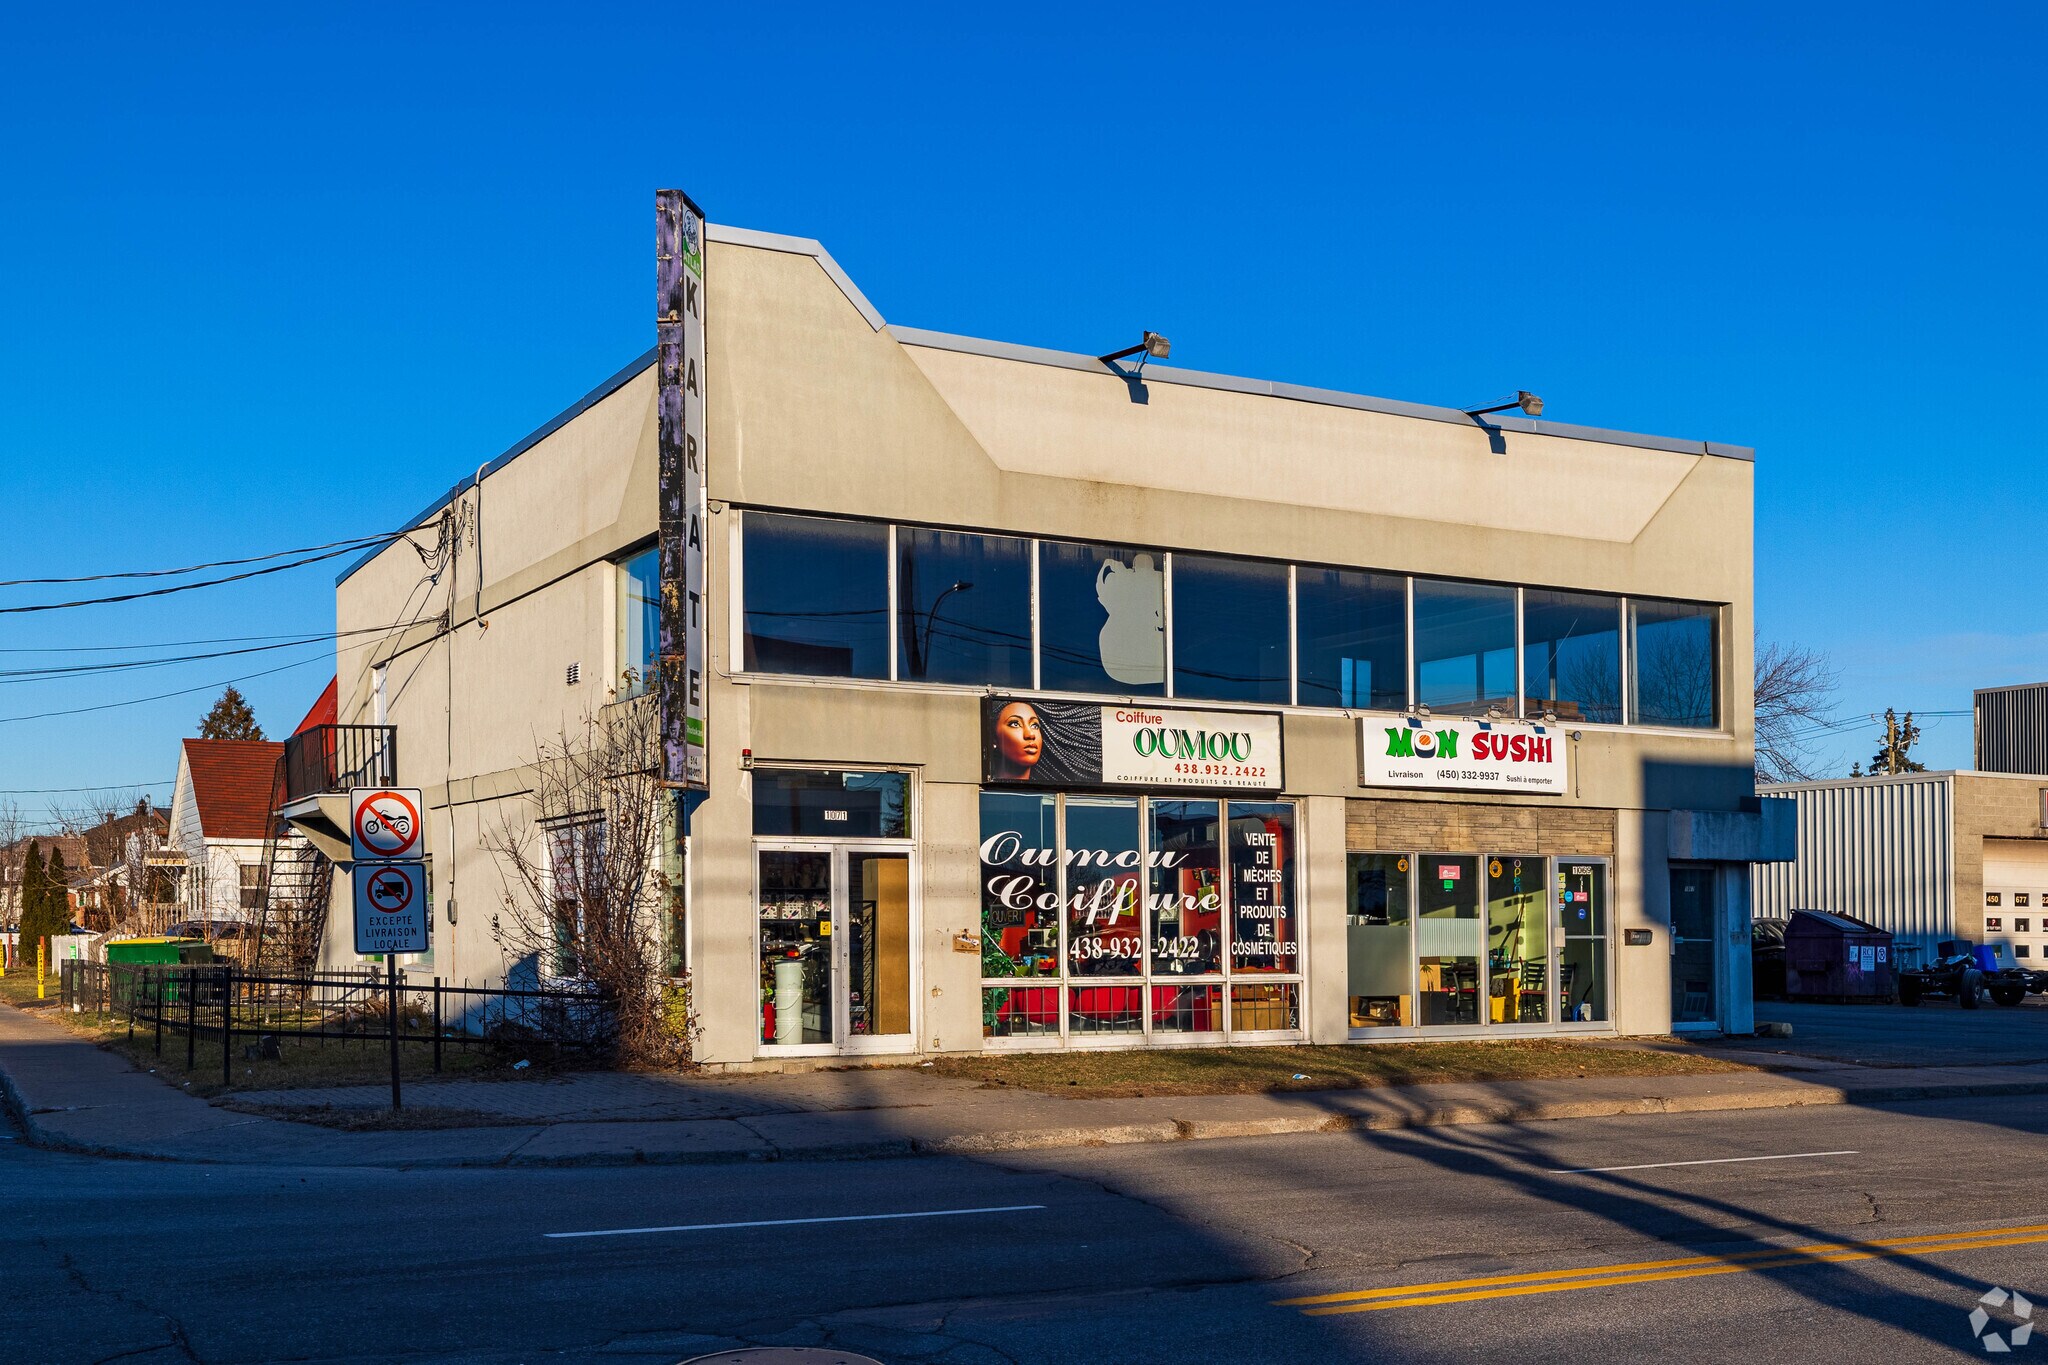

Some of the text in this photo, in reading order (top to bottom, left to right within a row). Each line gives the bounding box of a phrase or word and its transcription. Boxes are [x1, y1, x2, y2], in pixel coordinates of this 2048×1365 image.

[686, 275, 701, 708] KARATE
[1115, 711, 1163, 725] Coiffure
[1133, 727, 1252, 762] OUMOU
[1384, 727, 1553, 763] MON SUSHI
[1174, 763, 1267, 778] 438.932.2422
[1388, 769, 1500, 781] Livraison (450) 332-9937
[1116, 774, 1159, 783] COIFFURE
[1177, 777, 1218, 785] PRODUITS
[1237, 779, 1267, 787] BEAUTÉ
[1506, 774, 1553, 786] Sushi à emporter
[1246, 833, 1276, 847] VENTE
[979, 830, 1189, 868] Oumou
[1256, 851, 1269, 864] DE
[1243, 866, 1282, 883] MÈCHES
[987, 875, 1222, 925] Coiffure
[1256, 887, 1268, 901] ET
[1986, 895, 1999, 903] 450
[991, 910, 1022, 923] OUVERT
[1240, 905, 1287, 919] PRODUITS
[369, 915, 413, 926] EXCEPTÉ
[366, 927, 417, 938] LIVRAISON
[1257, 924, 1271, 937] DE
[374, 939, 410, 949] LOCALE
[1069, 936, 1200, 960] 438-932-2422
[1231, 939, 1297, 956] COSMÉTIQUES
